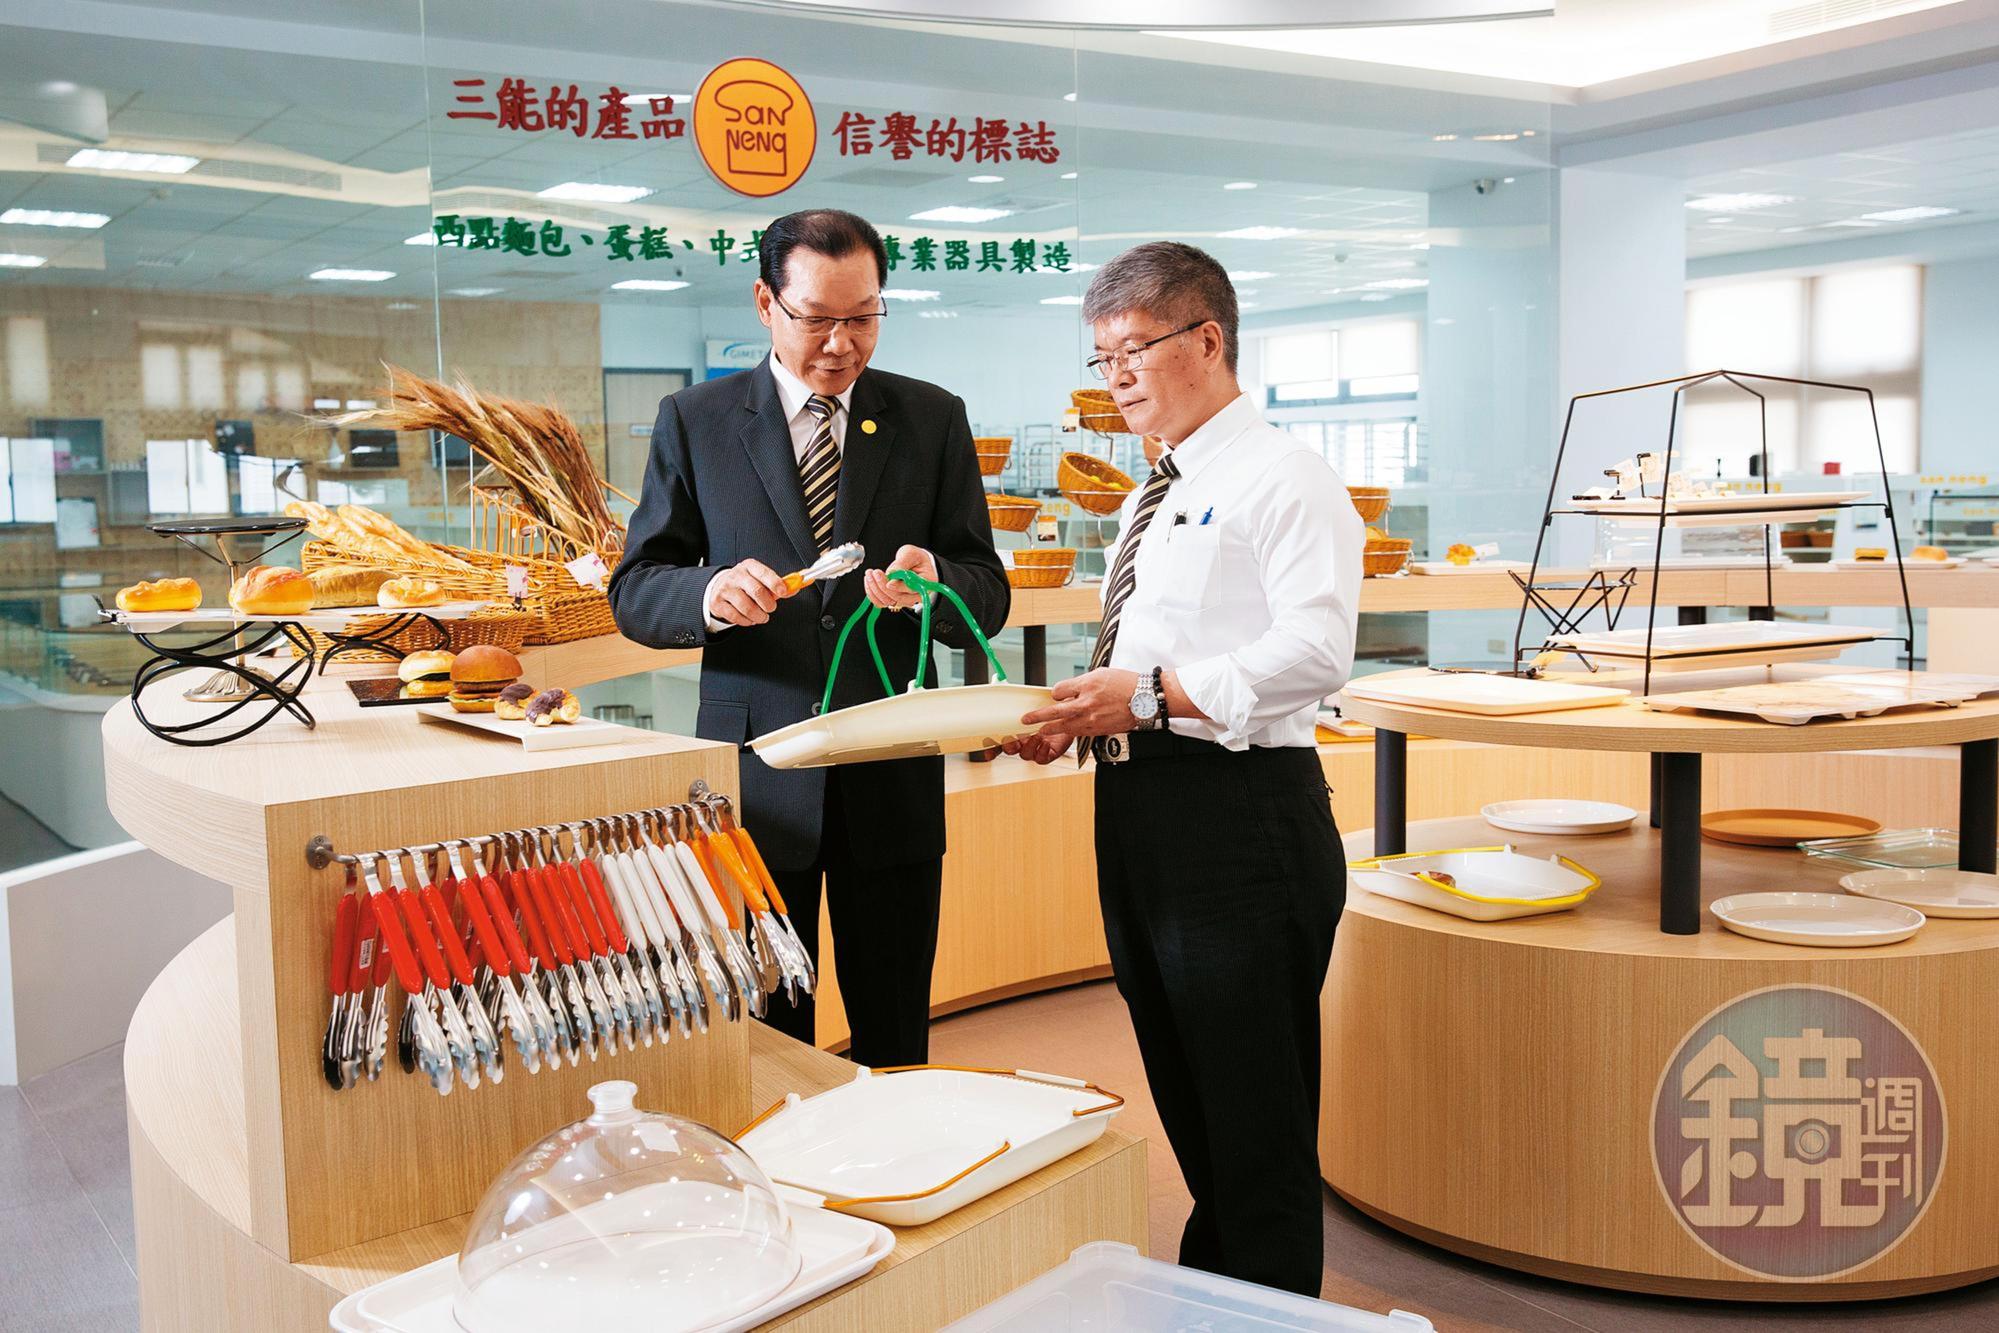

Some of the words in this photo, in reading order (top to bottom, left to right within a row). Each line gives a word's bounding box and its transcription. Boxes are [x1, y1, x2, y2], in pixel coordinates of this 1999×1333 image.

[446, 77, 687, 140] 三能的產品
[831, 111, 1060, 165] 信譽的標誌
